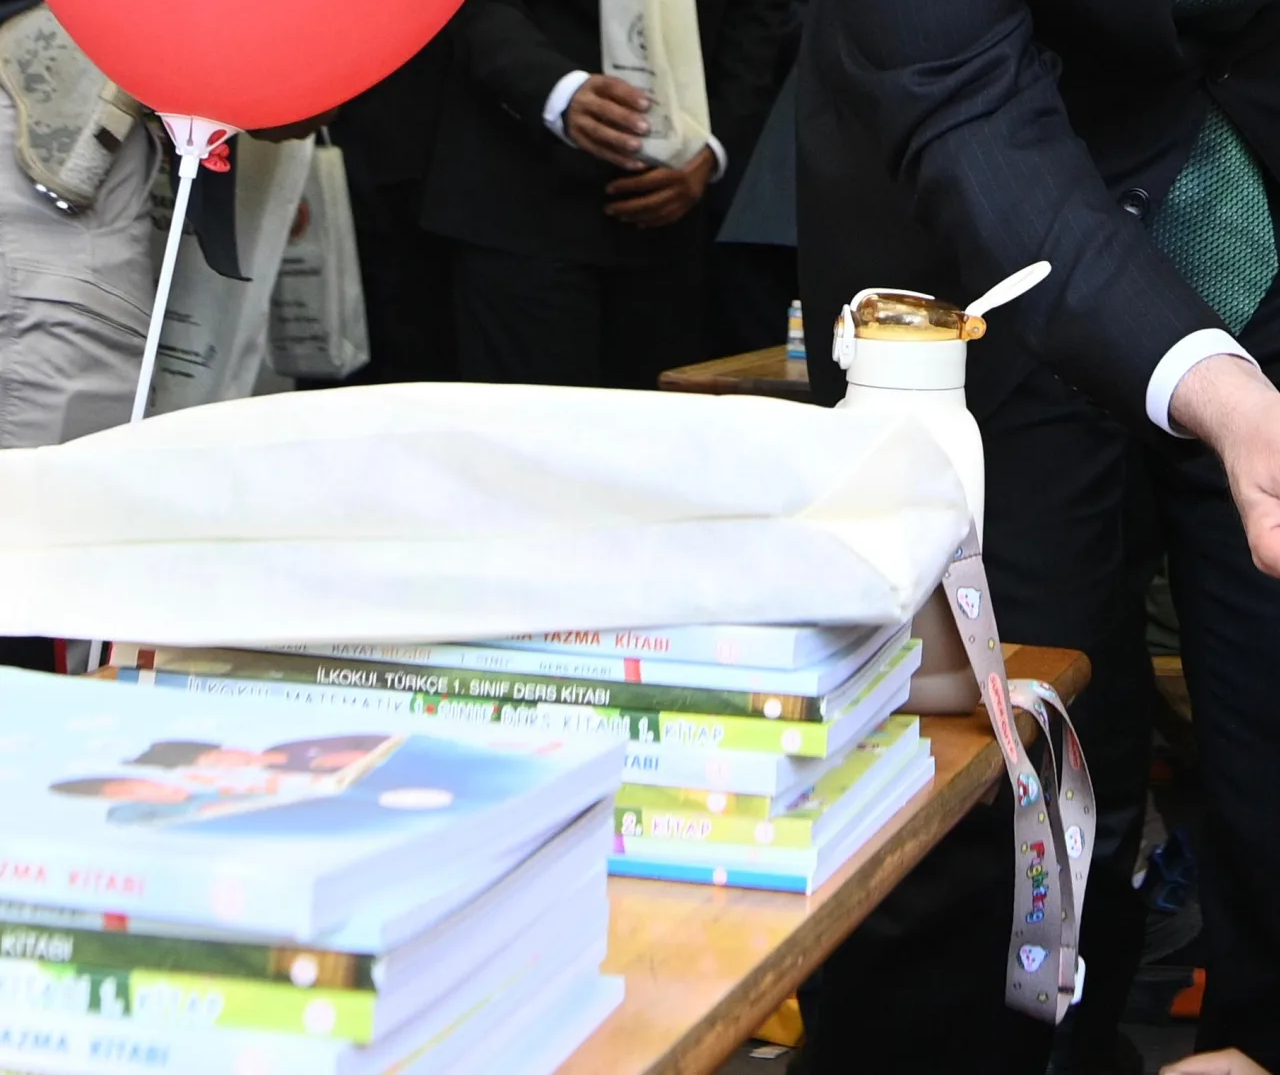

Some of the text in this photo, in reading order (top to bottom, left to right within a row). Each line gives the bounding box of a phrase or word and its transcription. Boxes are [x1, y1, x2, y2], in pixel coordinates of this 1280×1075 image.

[615, 627, 670, 652] KİTABI
[316, 665, 612, 706] İLKOKUL TÜRKÇE 1. SINIF DERS KİTABI
[664, 719, 724, 742] KİTAP
[652, 814, 712, 840] KİTAP
